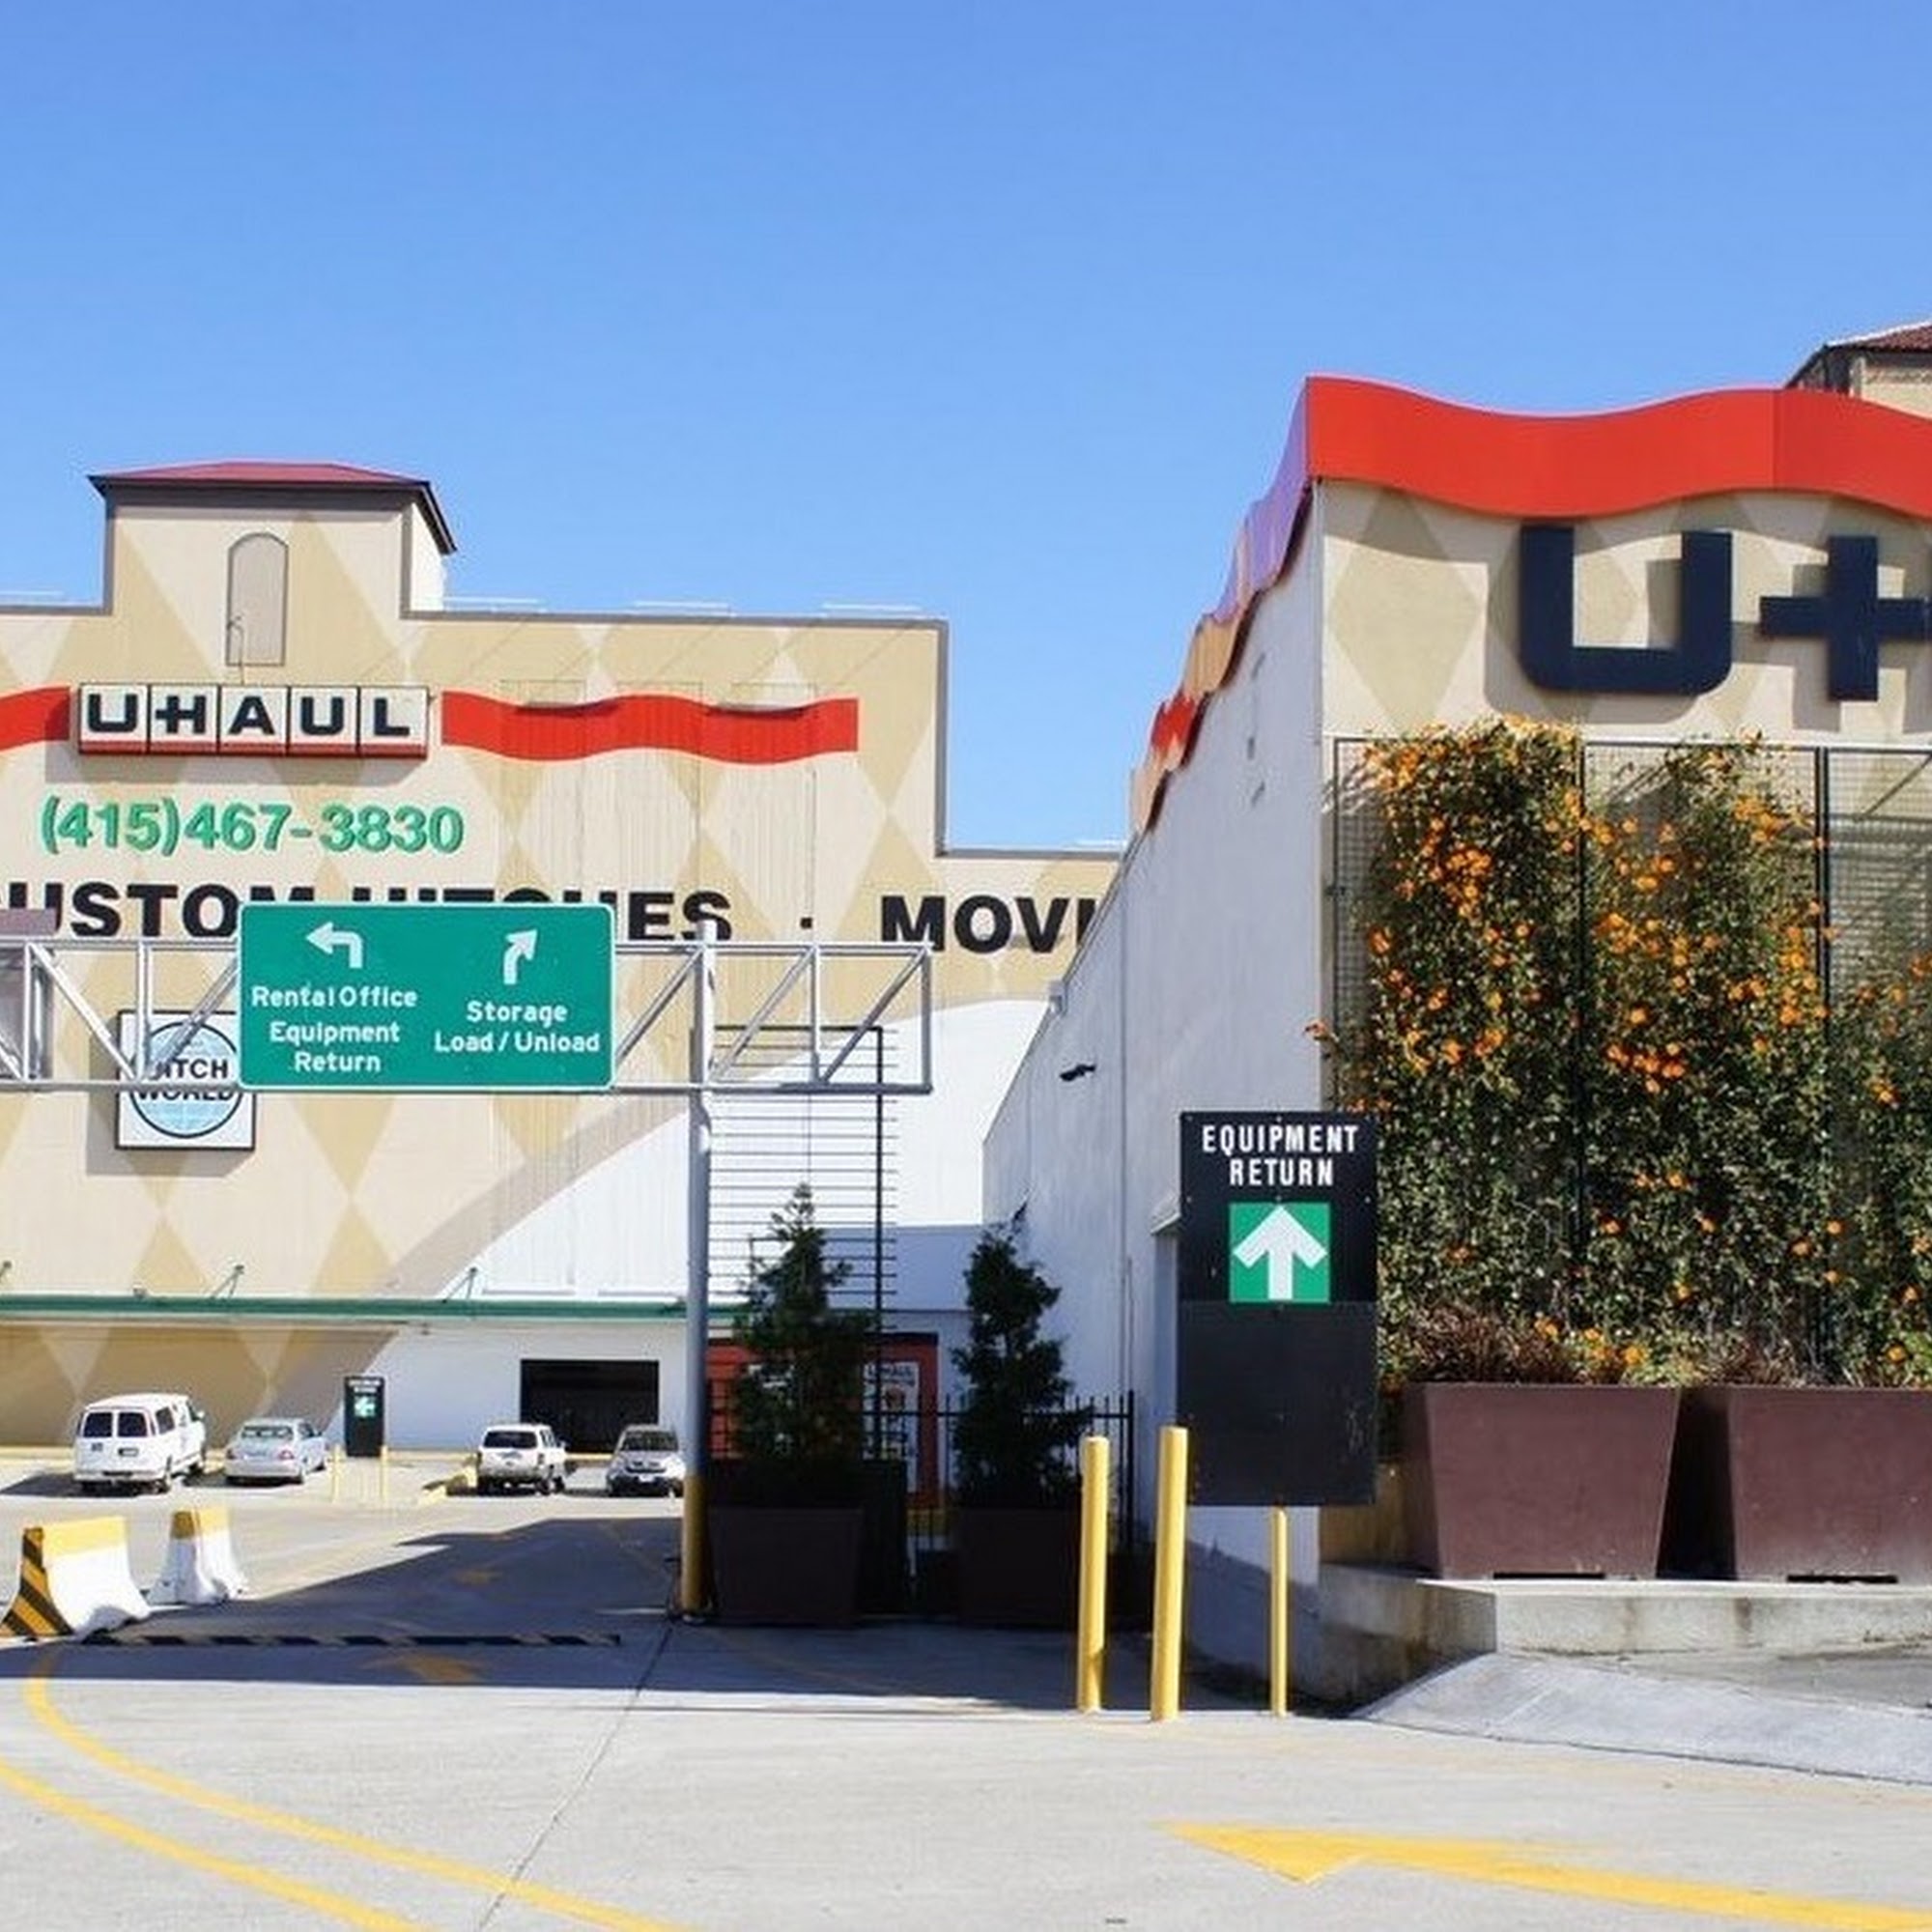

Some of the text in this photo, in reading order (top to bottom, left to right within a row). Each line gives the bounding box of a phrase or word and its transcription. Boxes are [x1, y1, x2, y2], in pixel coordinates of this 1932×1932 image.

[0, 882, 315, 938] USTO
[251, 985, 418, 1008] Rental Office
[467, 1000, 568, 1029] Storage
[270, 1020, 401, 1047] Equipment
[435, 1030, 494, 1052] Load
[514, 1030, 601, 1052] Unload
[152, 1058, 228, 1079] ITCH
[294, 1050, 382, 1072] Return
[1202, 1124, 1359, 1156] EQUIPMENT
[1229, 1158, 1334, 1186] RETURN
